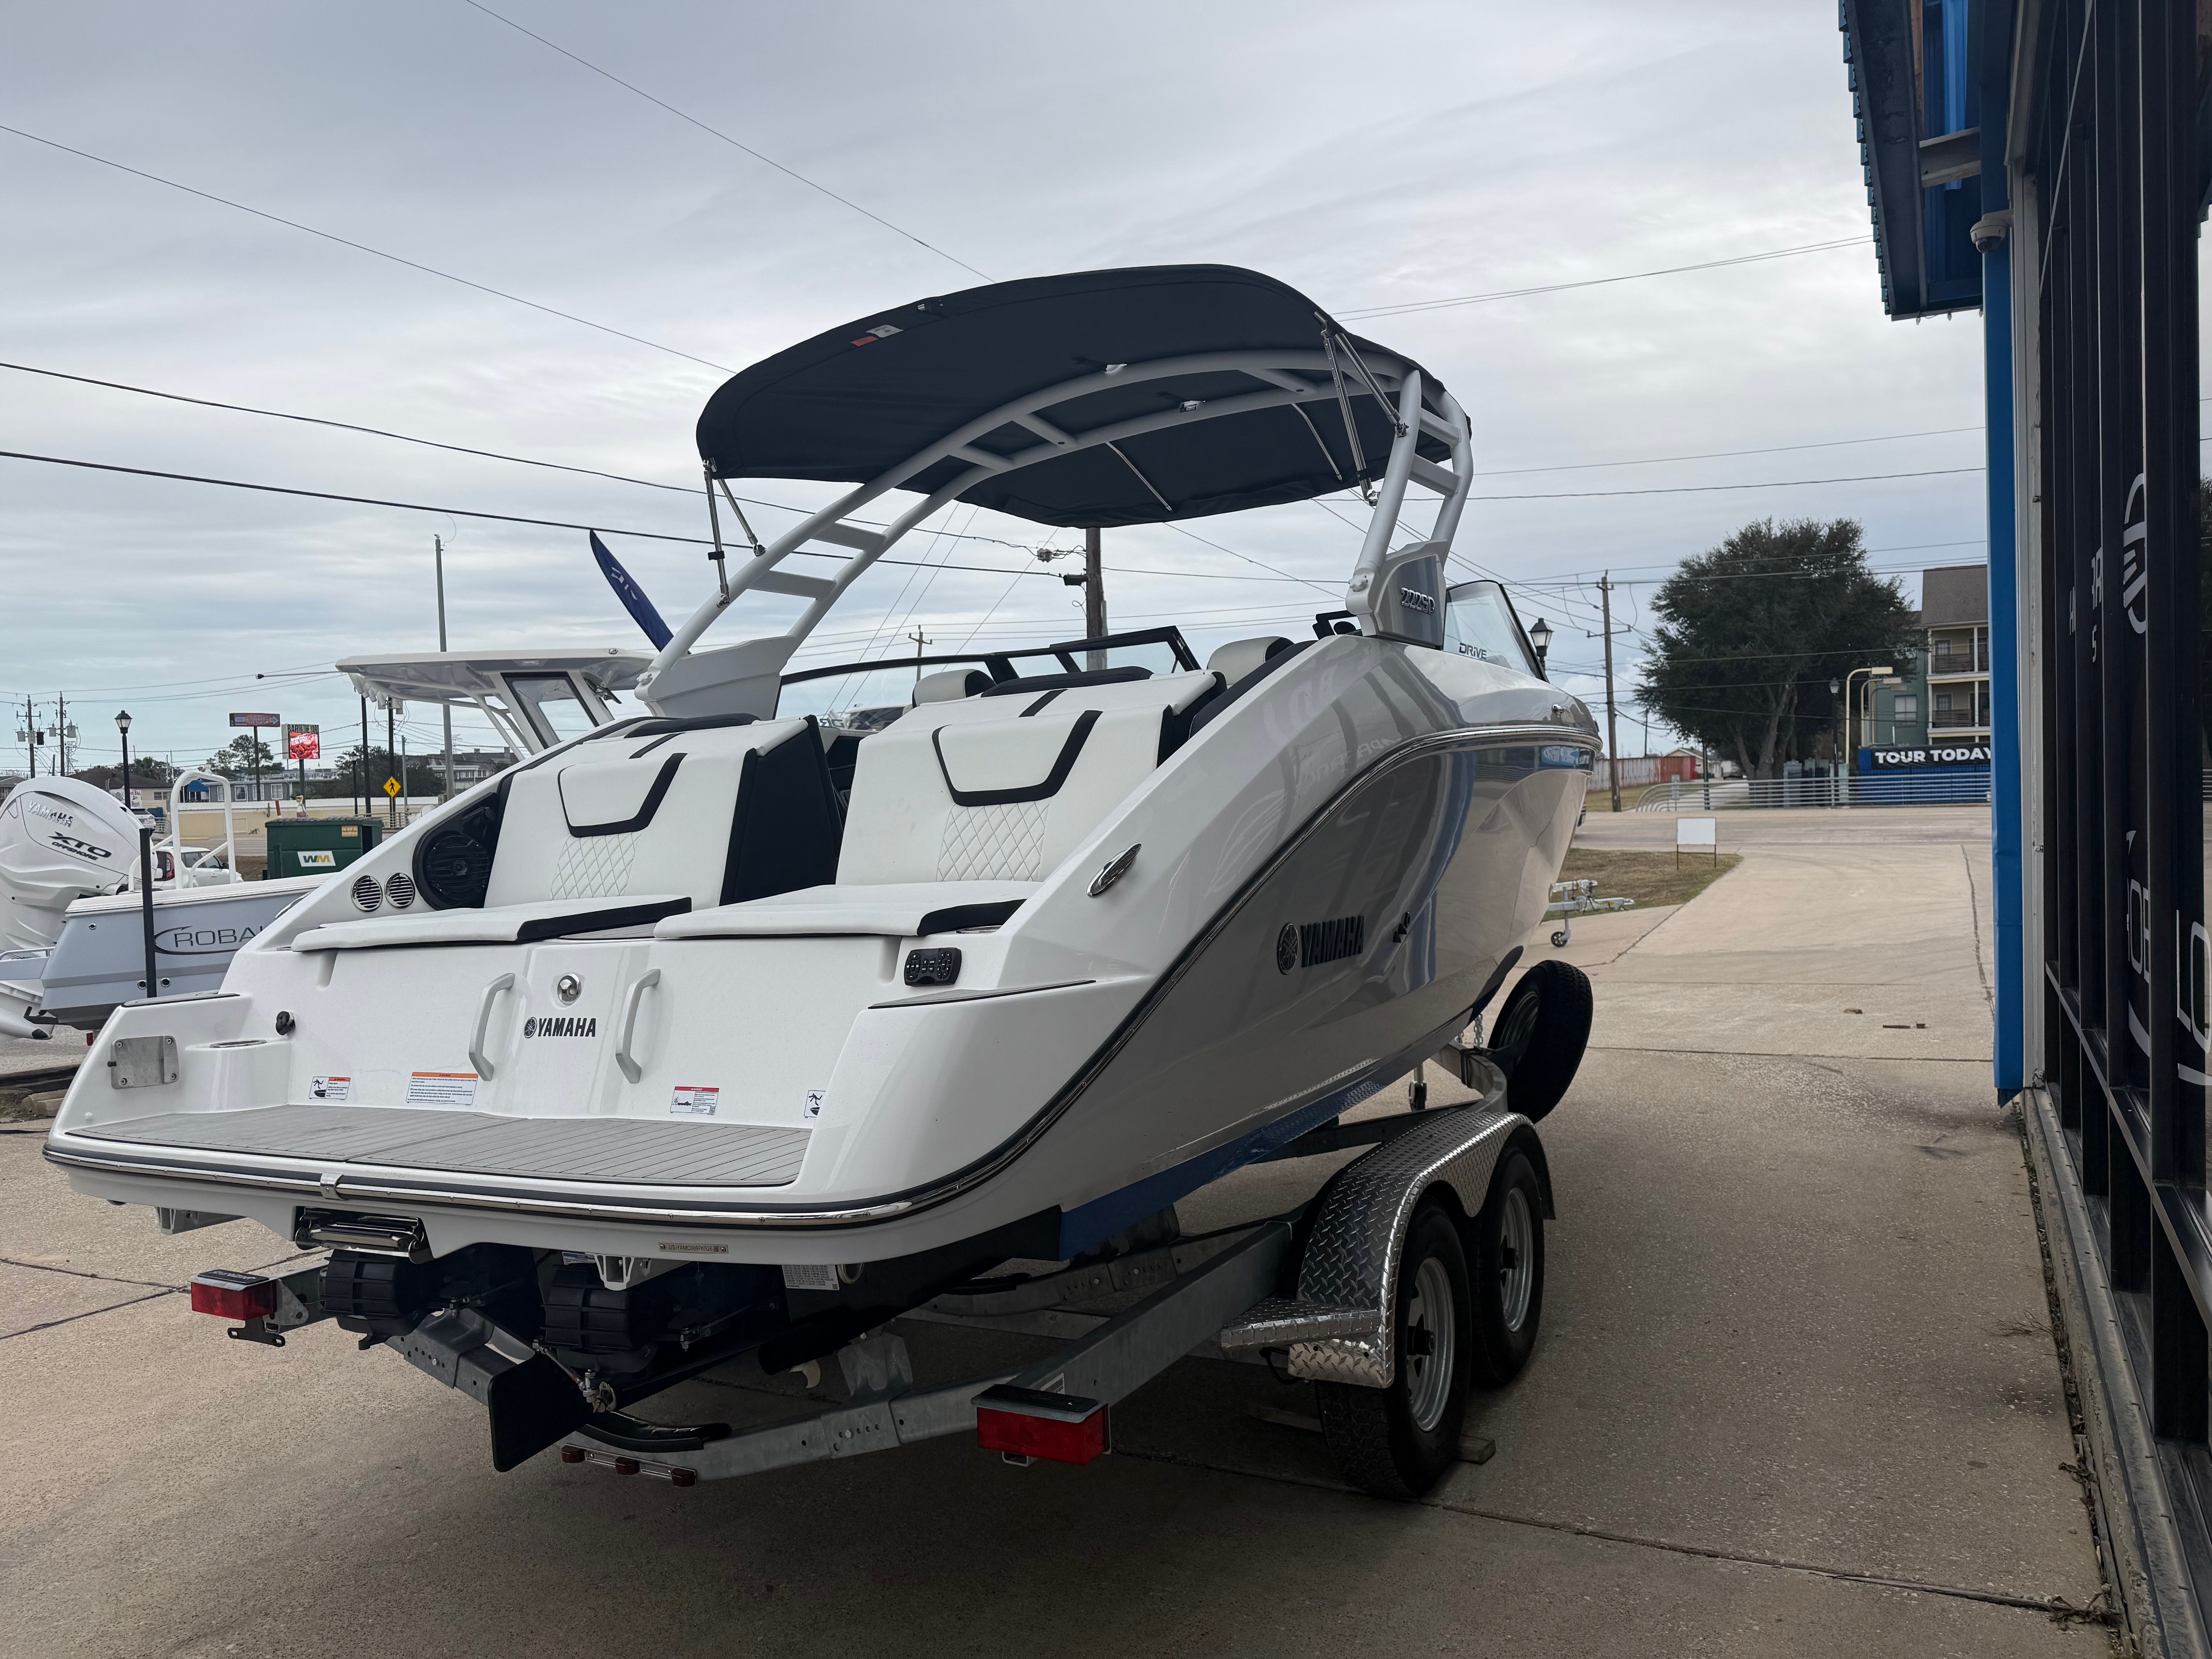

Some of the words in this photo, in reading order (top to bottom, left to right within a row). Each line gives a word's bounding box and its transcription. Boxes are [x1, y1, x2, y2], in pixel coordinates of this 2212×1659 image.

[1401, 587, 1435, 614] 222SD
[1875, 750, 1926, 764] TOUR
[28, 800, 73, 827] YAMAHA
[47, 831, 112, 858] XTO
[52, 842, 98, 861] OFFSHORE
[303, 855, 331, 863] WM
[1300, 915, 1364, 968] YAMAHA
[538, 1018, 596, 1037] YAMAHA
